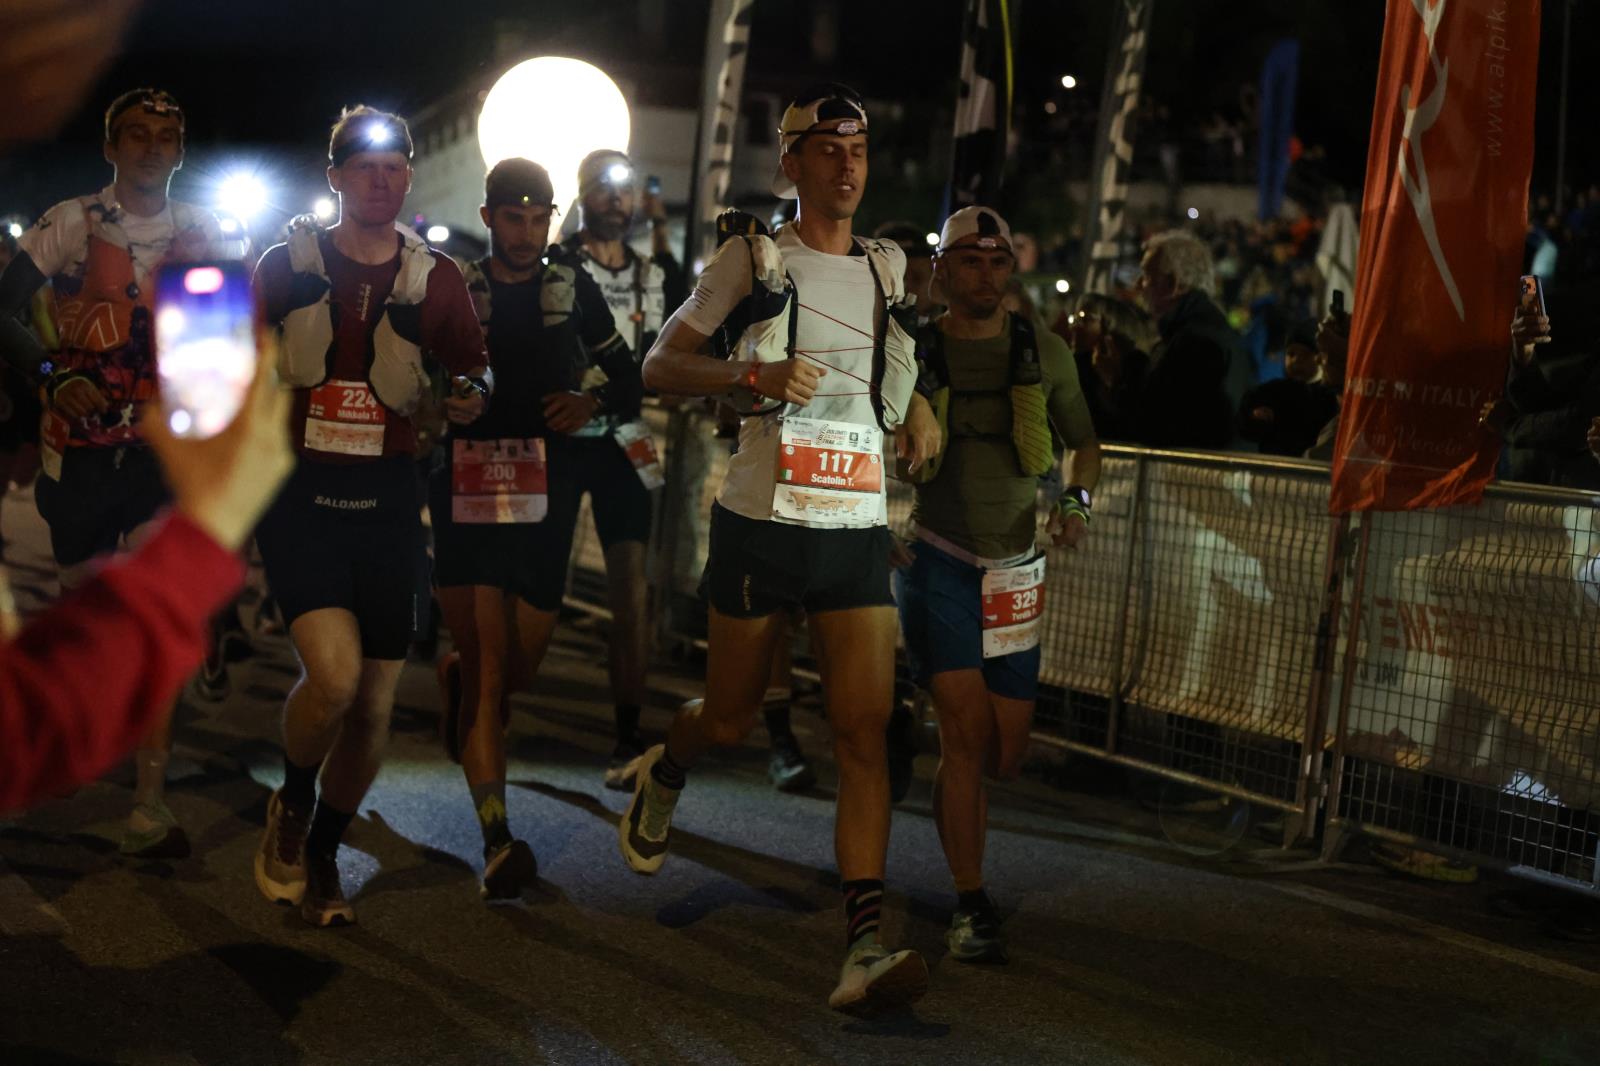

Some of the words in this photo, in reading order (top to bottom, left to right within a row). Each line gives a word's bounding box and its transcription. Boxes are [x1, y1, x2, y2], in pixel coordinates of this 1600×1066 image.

[342, 389, 377, 409] 224
[1394, 381, 1413, 401] IN
[1421, 384, 1481, 409] ITALY
[483, 463, 516, 481] 200
[818, 451, 853, 474] 117
[811, 473, 846, 486] Scatolin
[847, 477, 855, 487] T.
[314, 495, 377, 509] SALOMON
[1012, 588, 1038, 610] 329
